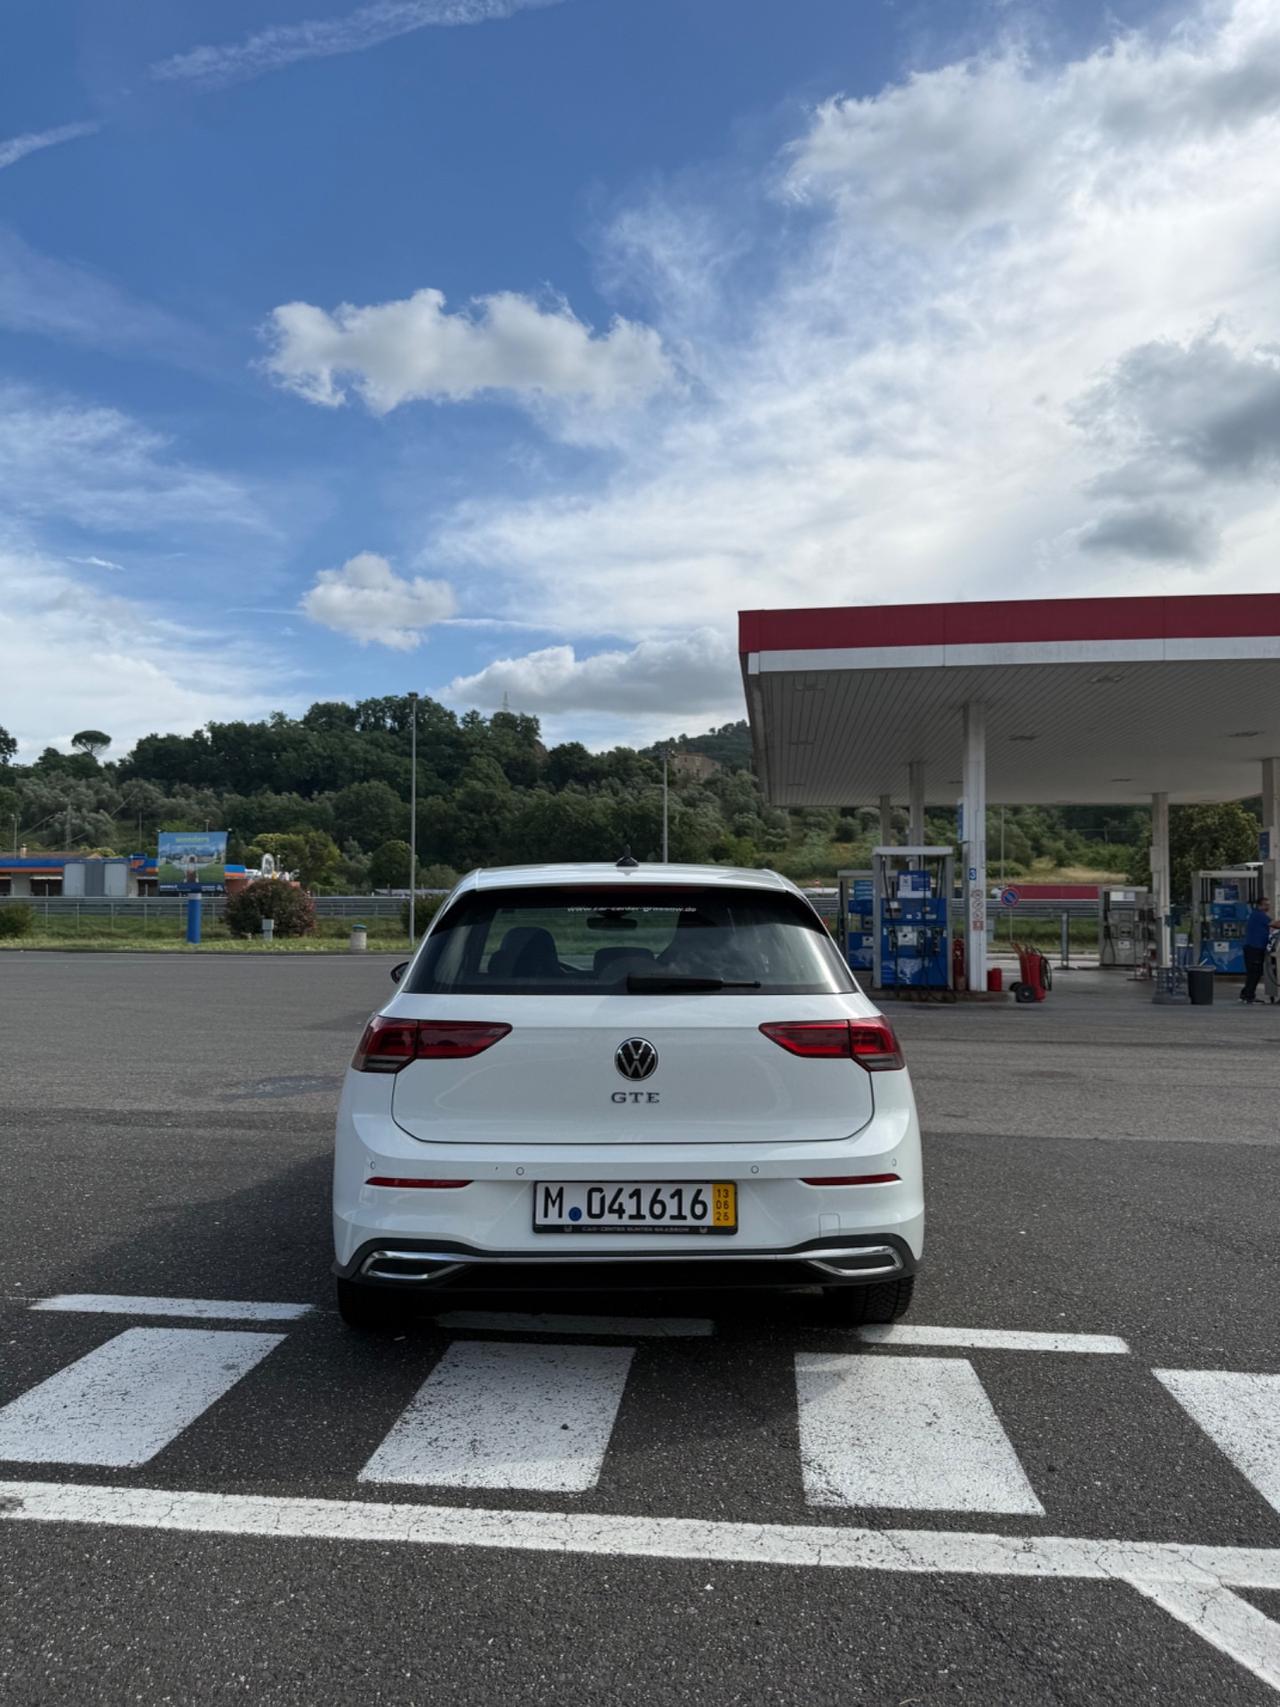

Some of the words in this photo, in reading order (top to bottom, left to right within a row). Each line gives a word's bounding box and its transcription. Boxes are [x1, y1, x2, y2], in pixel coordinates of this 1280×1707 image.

[615, 1038, 658, 1080] VW
[610, 1091, 660, 1104] GTE
[543, 1186, 564, 1219] M
[586, 1187, 708, 1221] 041616
[716, 1188, 729, 1199] 13
